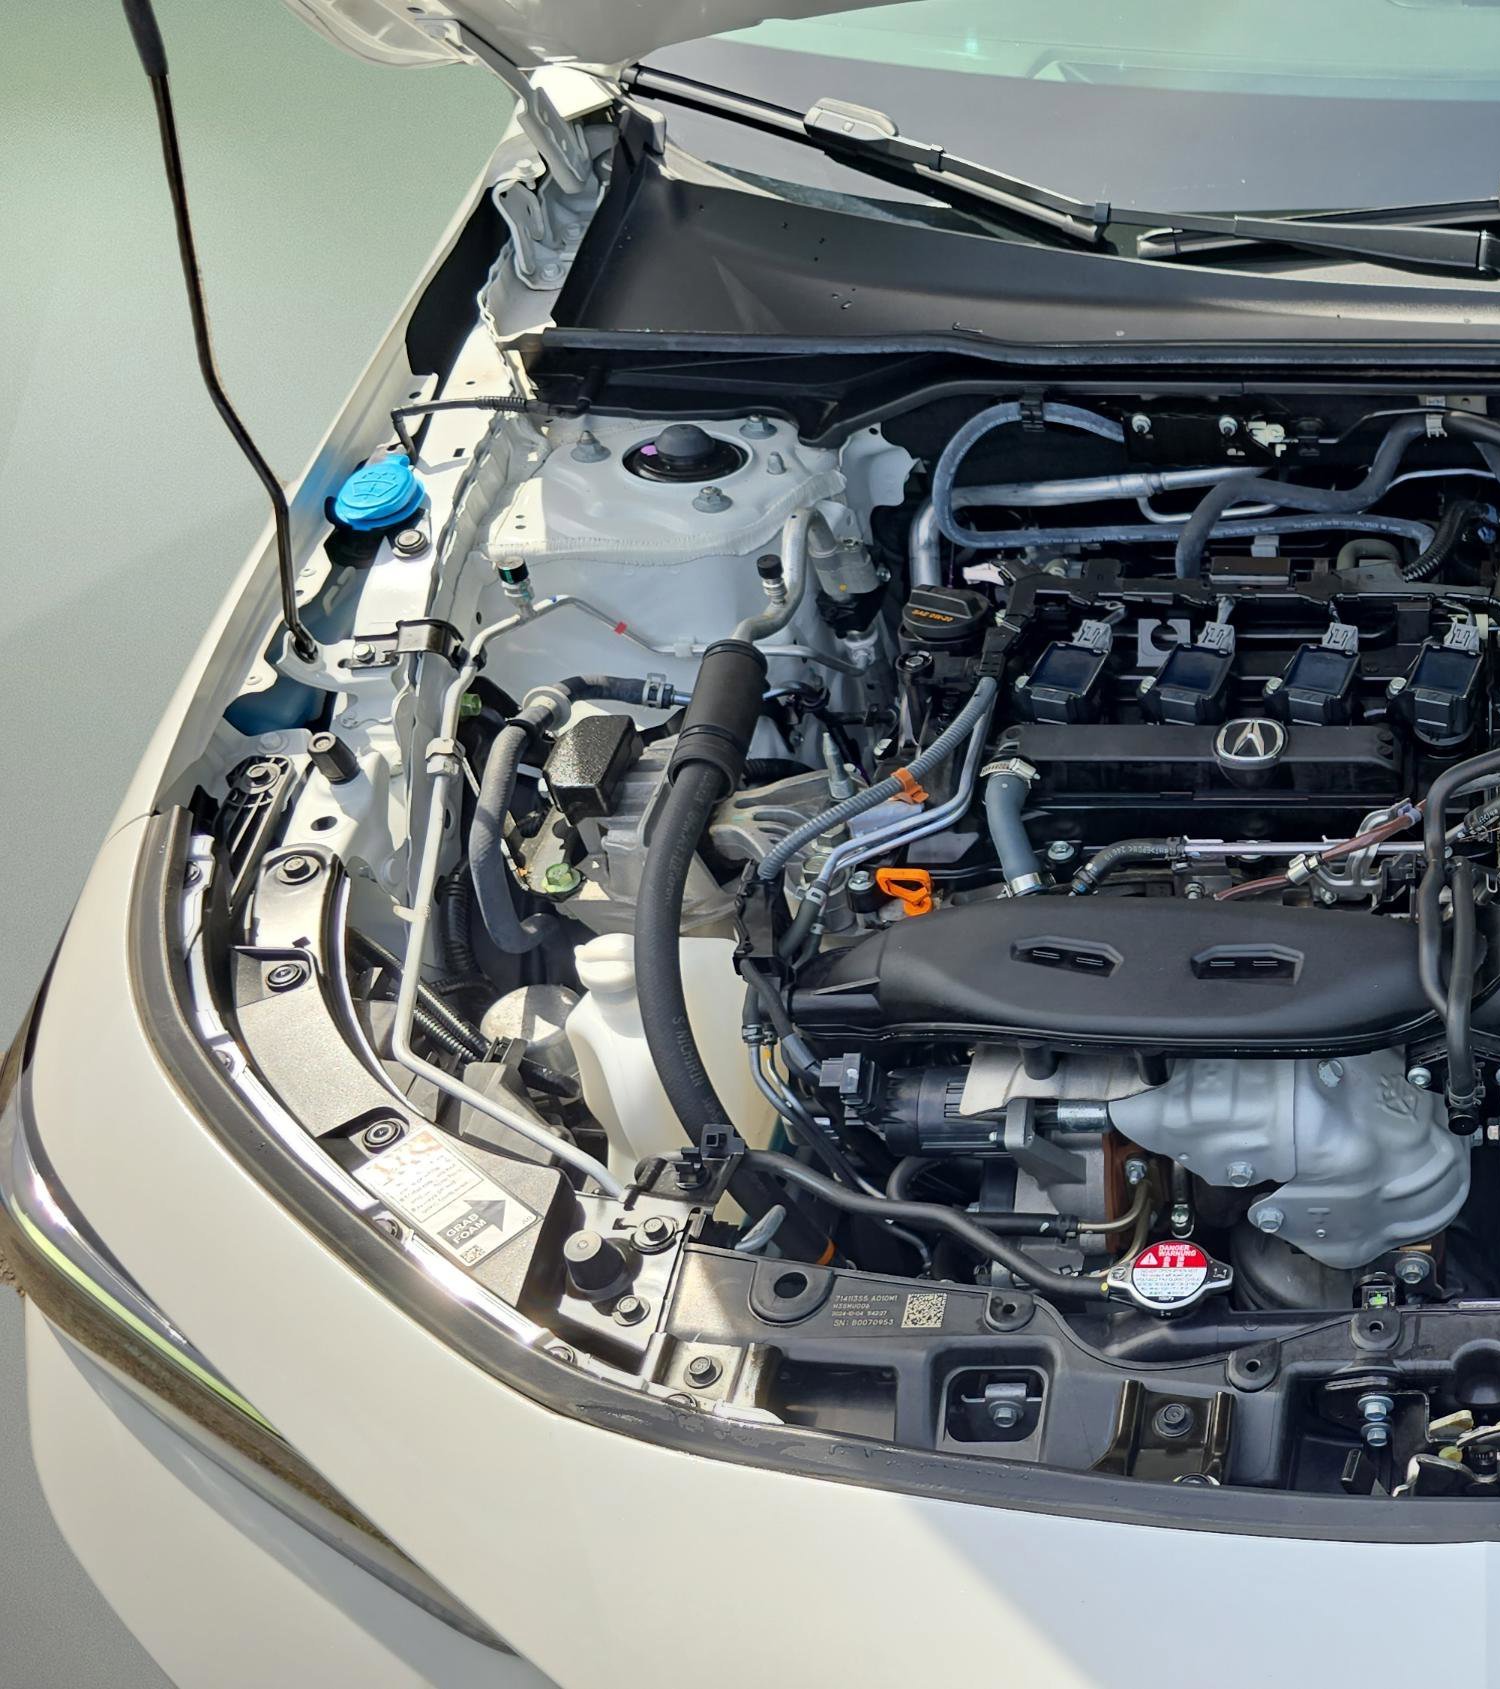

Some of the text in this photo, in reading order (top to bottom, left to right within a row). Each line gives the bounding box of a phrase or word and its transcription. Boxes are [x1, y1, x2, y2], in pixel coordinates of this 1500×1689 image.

[675, 1030, 706, 1088] NICHIRIN
[446, 1213, 479, 1237] GRAB
[453, 1218, 487, 1243] FOAM
